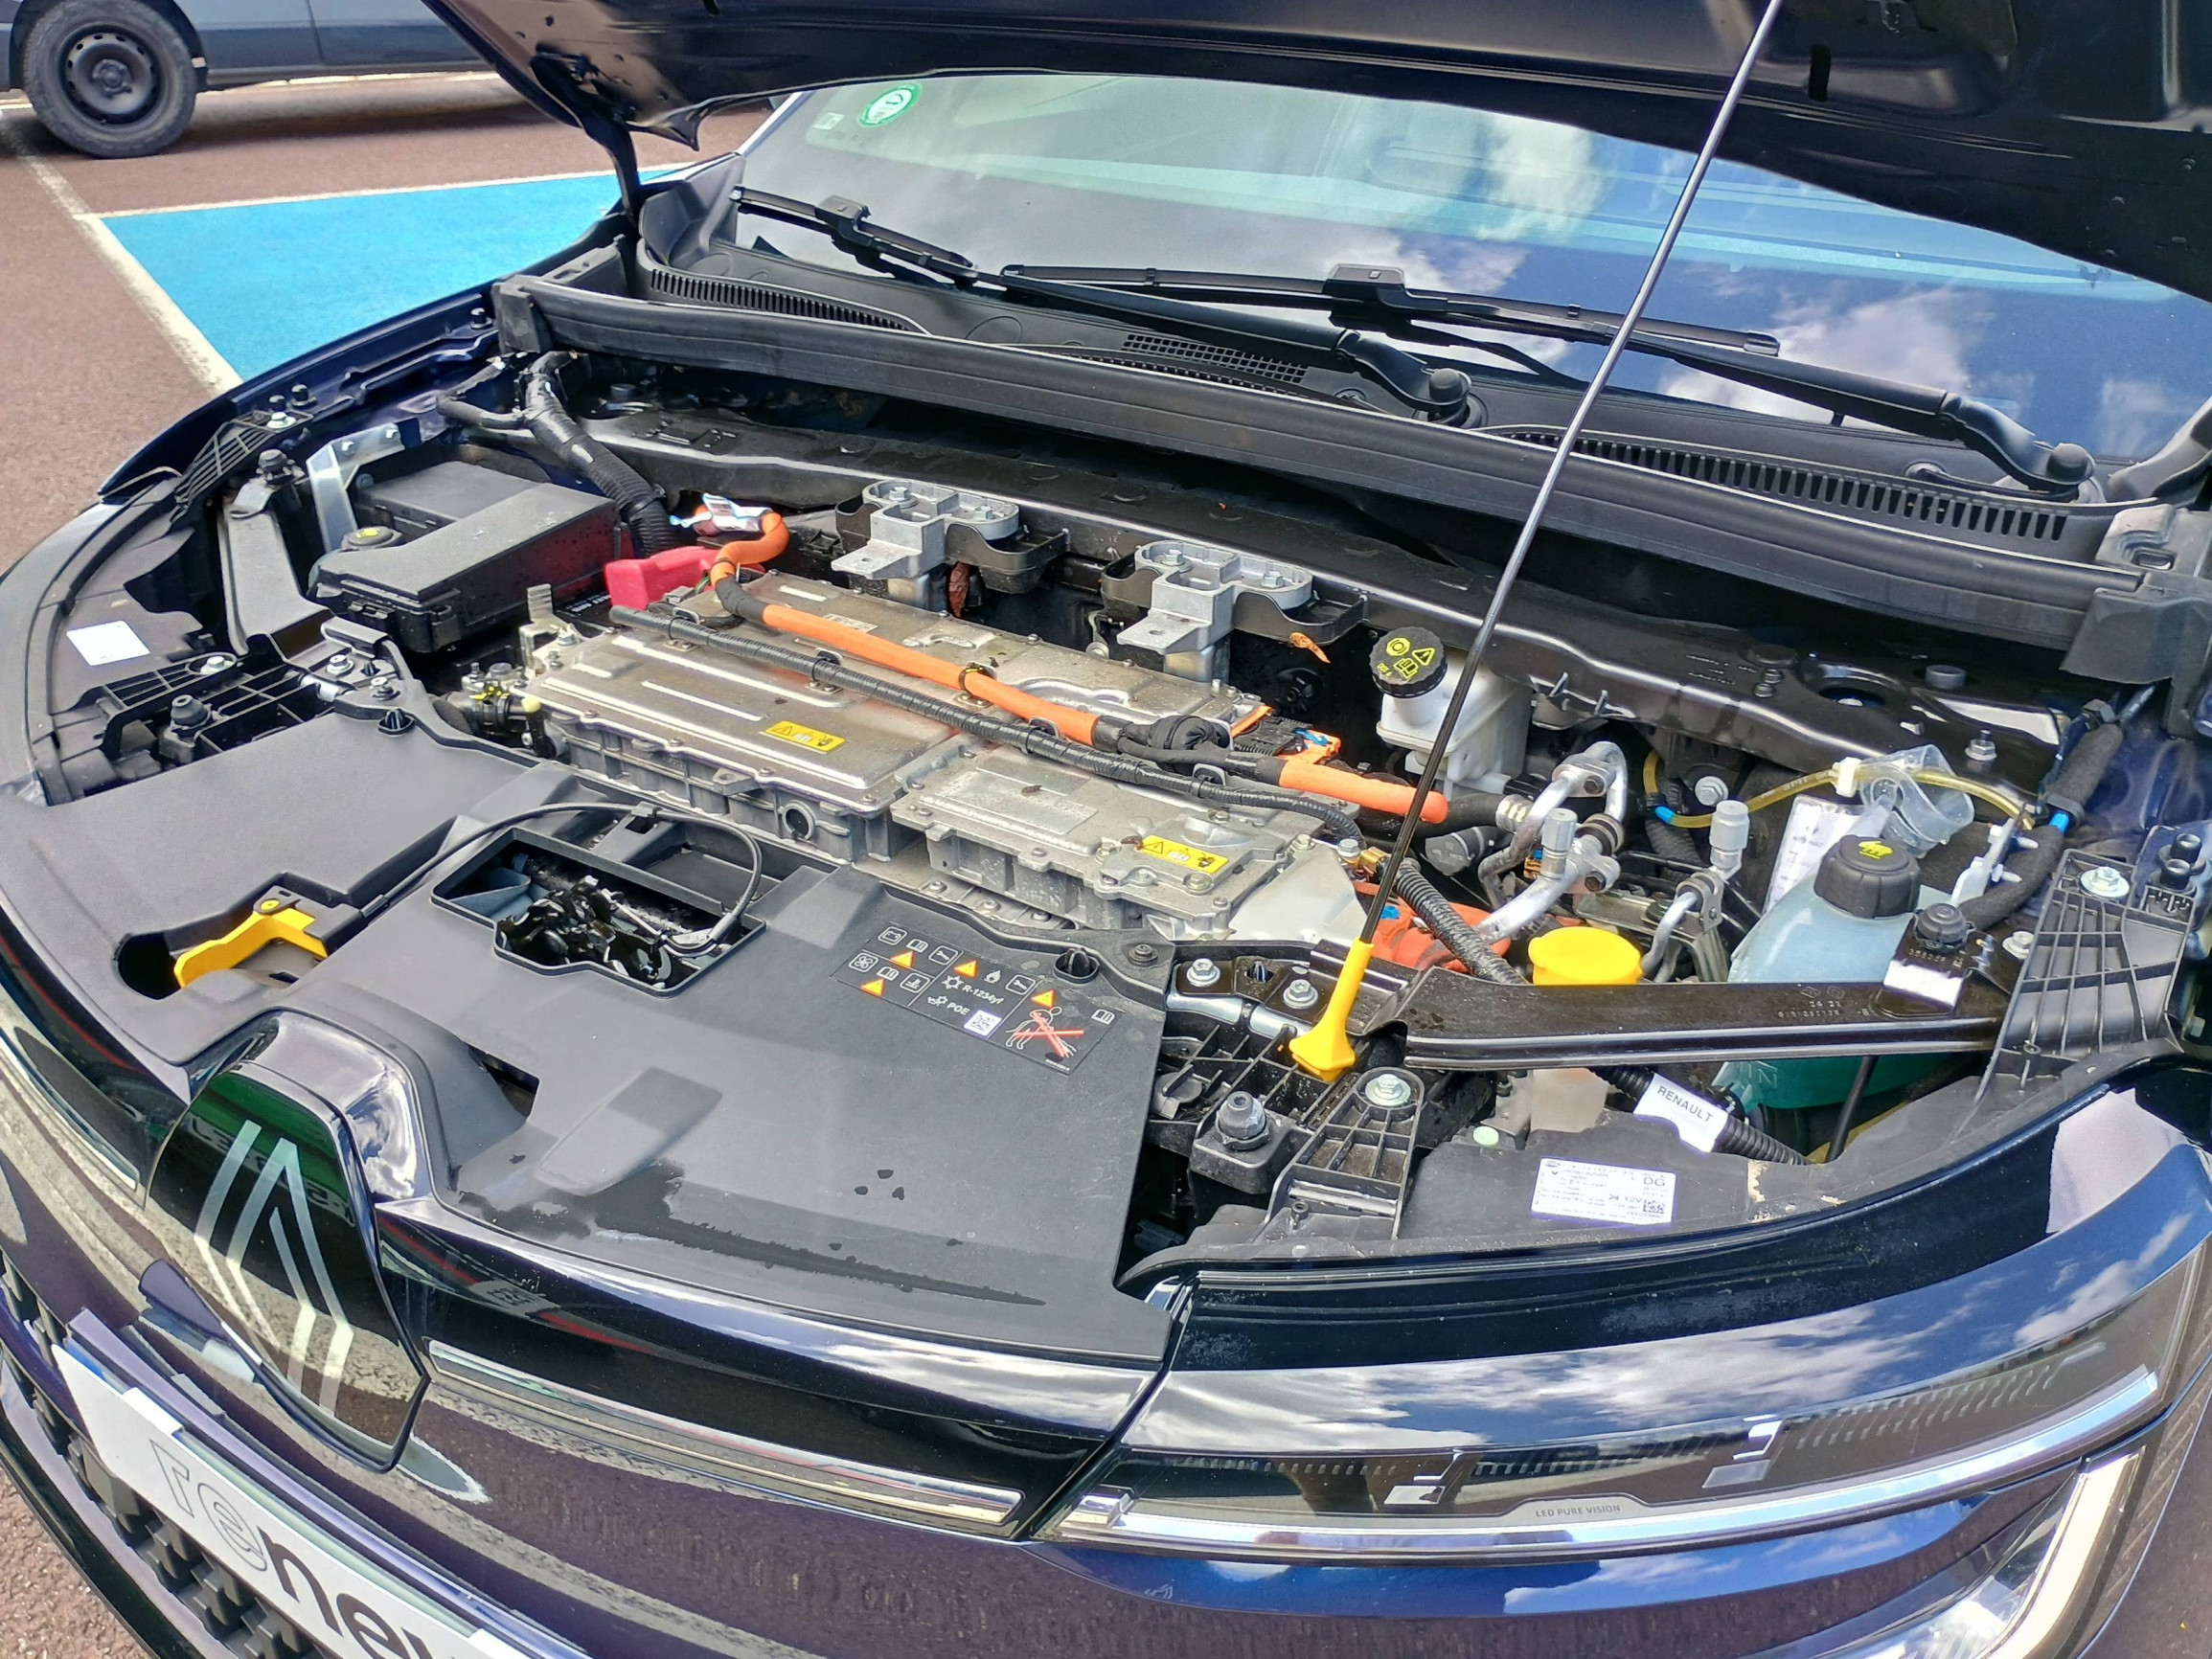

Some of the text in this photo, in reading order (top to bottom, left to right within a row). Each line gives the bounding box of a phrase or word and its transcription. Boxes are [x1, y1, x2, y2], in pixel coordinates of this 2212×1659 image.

[962, 985, 1005, 1005] R-1234yf
[946, 1002, 970, 1015] POE
[1657, 1085, 1713, 1122] RENAULT
[1535, 1504, 1621, 1517] LED PURE VISION
[148, 1438, 456, 1659] rene
